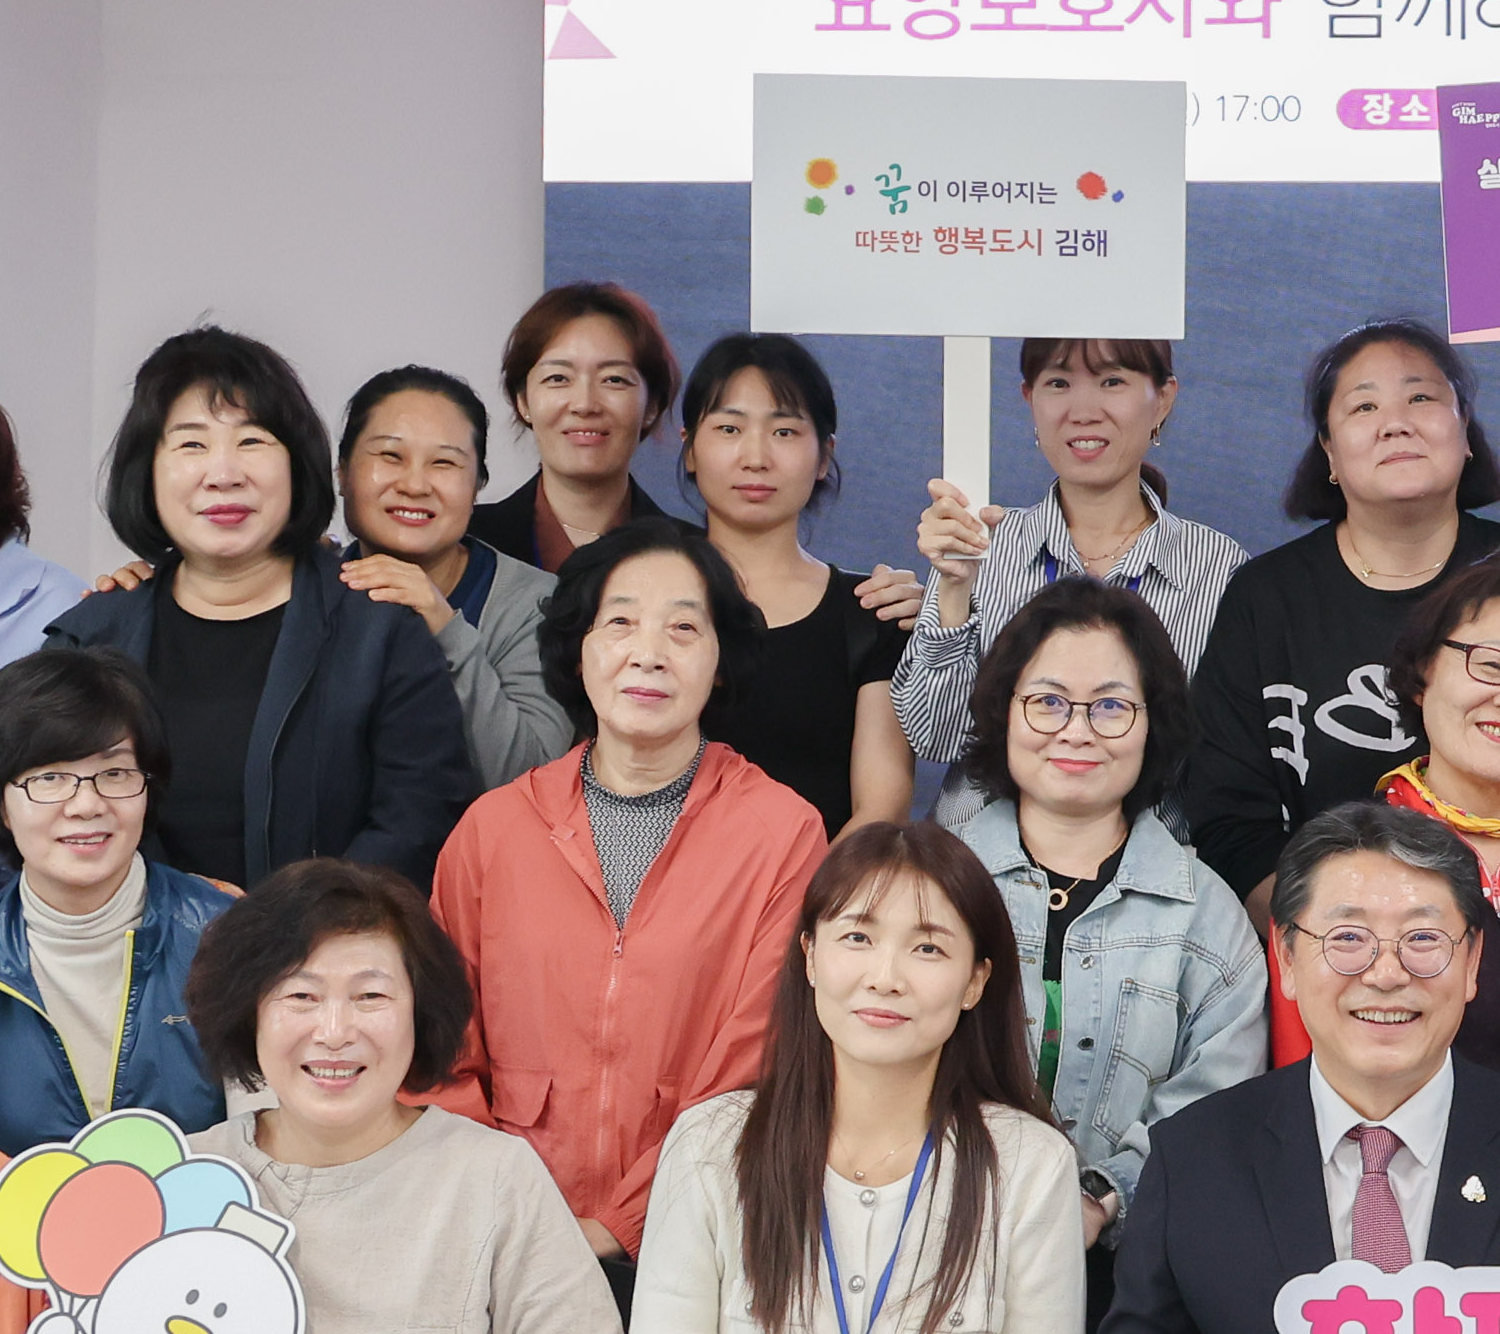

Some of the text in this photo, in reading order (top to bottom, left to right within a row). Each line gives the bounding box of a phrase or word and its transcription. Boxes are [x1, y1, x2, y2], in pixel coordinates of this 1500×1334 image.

[1216, 94, 1301, 122] 17:00
[1452, 107, 1476, 117] GIM
[947, 180, 1058, 204] 이루어지는
[855, 227, 1108, 257] 따뜻한 행복도시 김해
